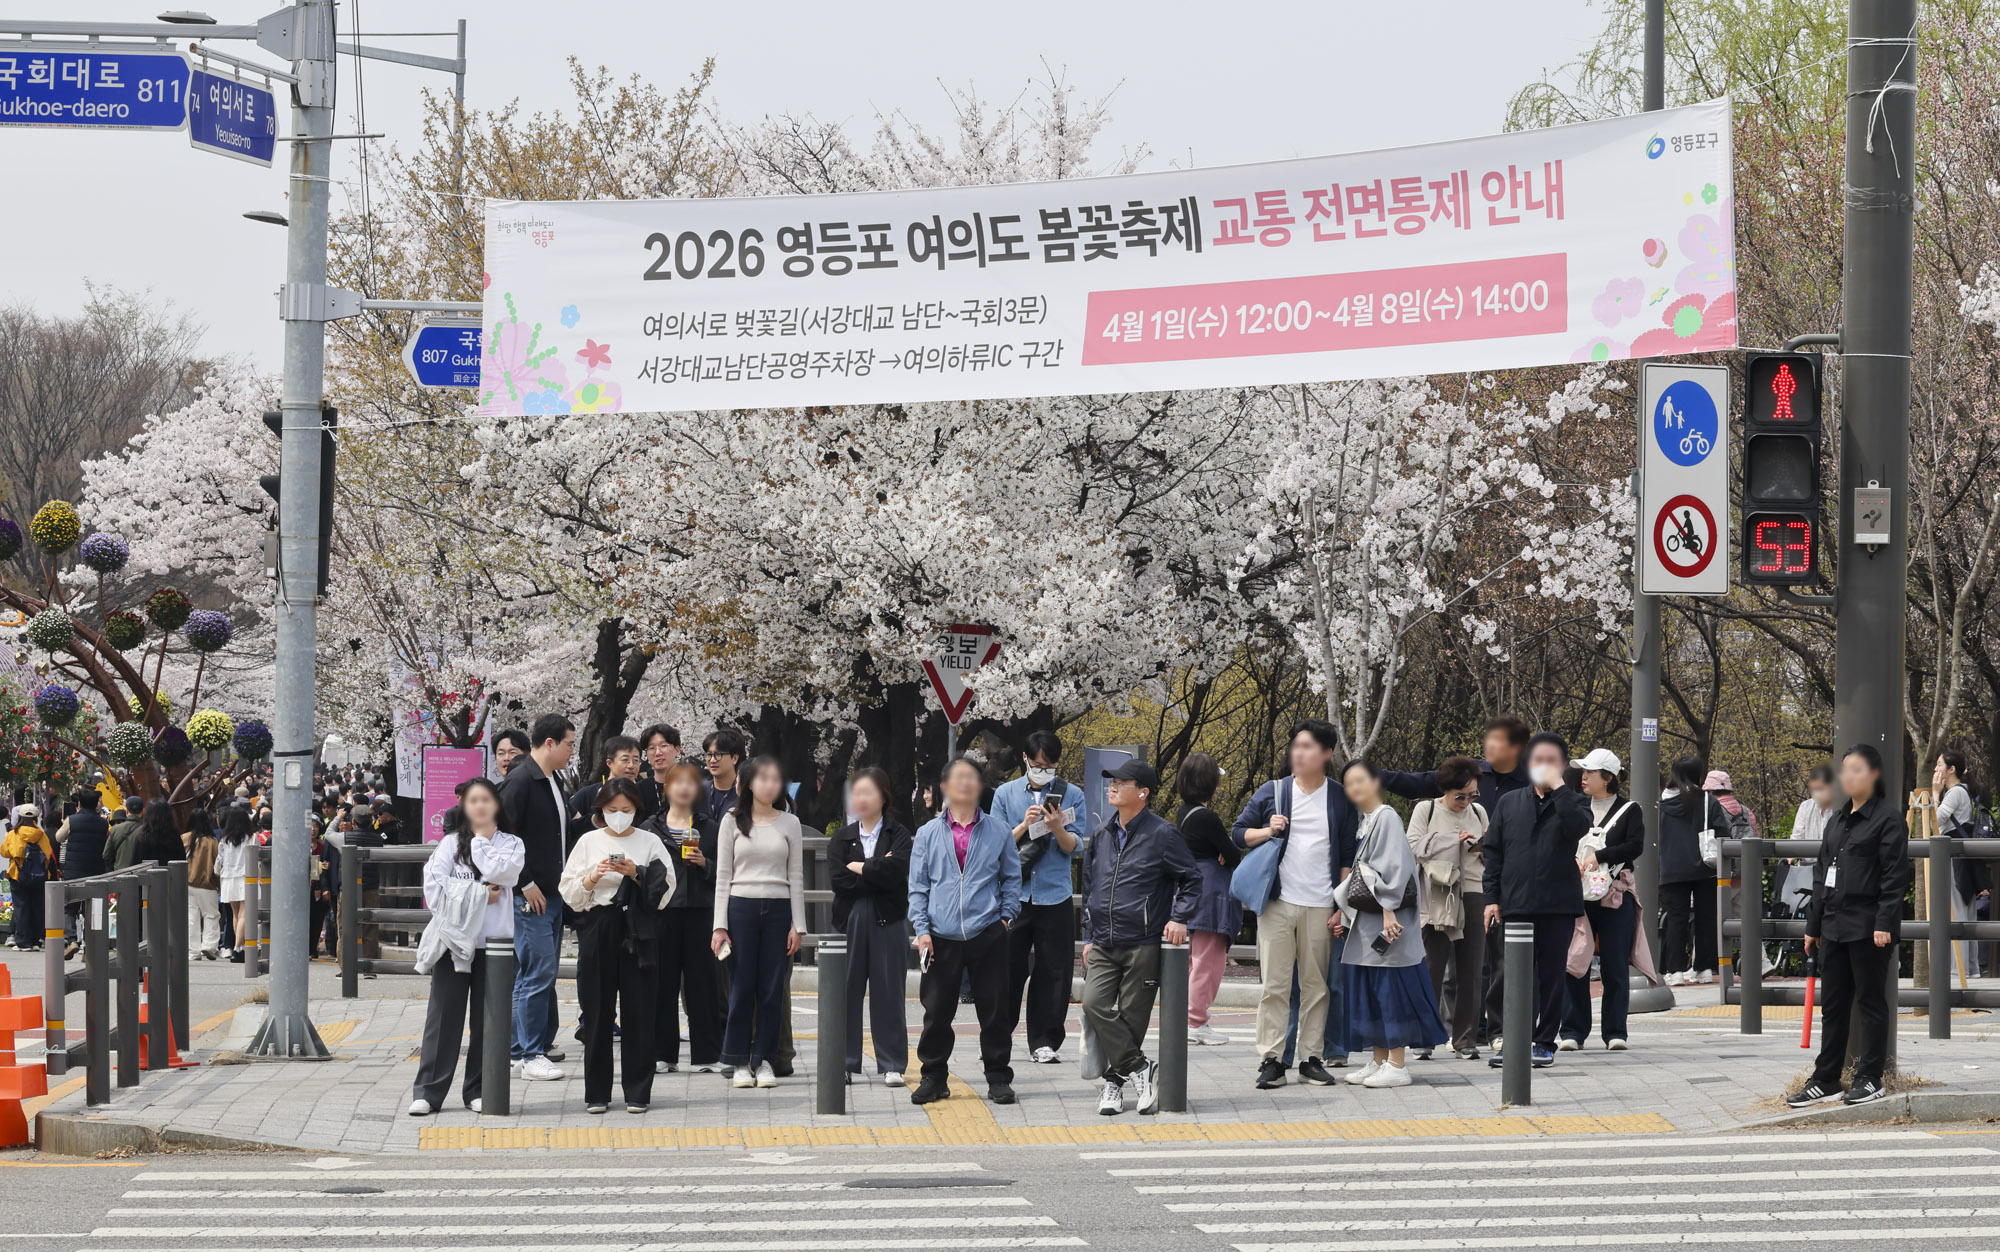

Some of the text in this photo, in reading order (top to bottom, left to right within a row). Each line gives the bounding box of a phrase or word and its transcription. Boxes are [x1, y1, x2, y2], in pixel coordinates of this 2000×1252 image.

[0, 57, 125, 91] 국회대로
[137, 78, 180, 103] 811
[191, 92, 201, 114] 74
[210, 81, 255, 122] 여의서로
[215, 123, 252, 150] Yeouiseo-ro
[266, 115, 275, 136] 78
[1670, 132, 1718, 153] 영등포구
[643, 159, 1566, 281] 2026 영등포 여의도 봄꽃축제 교통 전면통제 안내
[531, 231, 555, 248] 영등포
[643, 294, 1048, 341] 여의서로 벚꽃길(서강대교 남단~국회3문)
[1102, 309, 1145, 343] 4월
[1150, 304, 1228, 341] 1일(수)
[1380, 285, 1464, 324] 8일(수)
[1471, 279, 1549, 317] 14:00
[421, 349, 448, 364] 807
[637, 347, 876, 384] 서강대교남단공영주차장
[1019, 338, 1064, 369] 구간
[1756, 521, 1810, 572] 53
[940, 655, 972, 670] YIELD
[1644, 728, 1656, 737] 112
[399, 755, 413, 787] 함께
